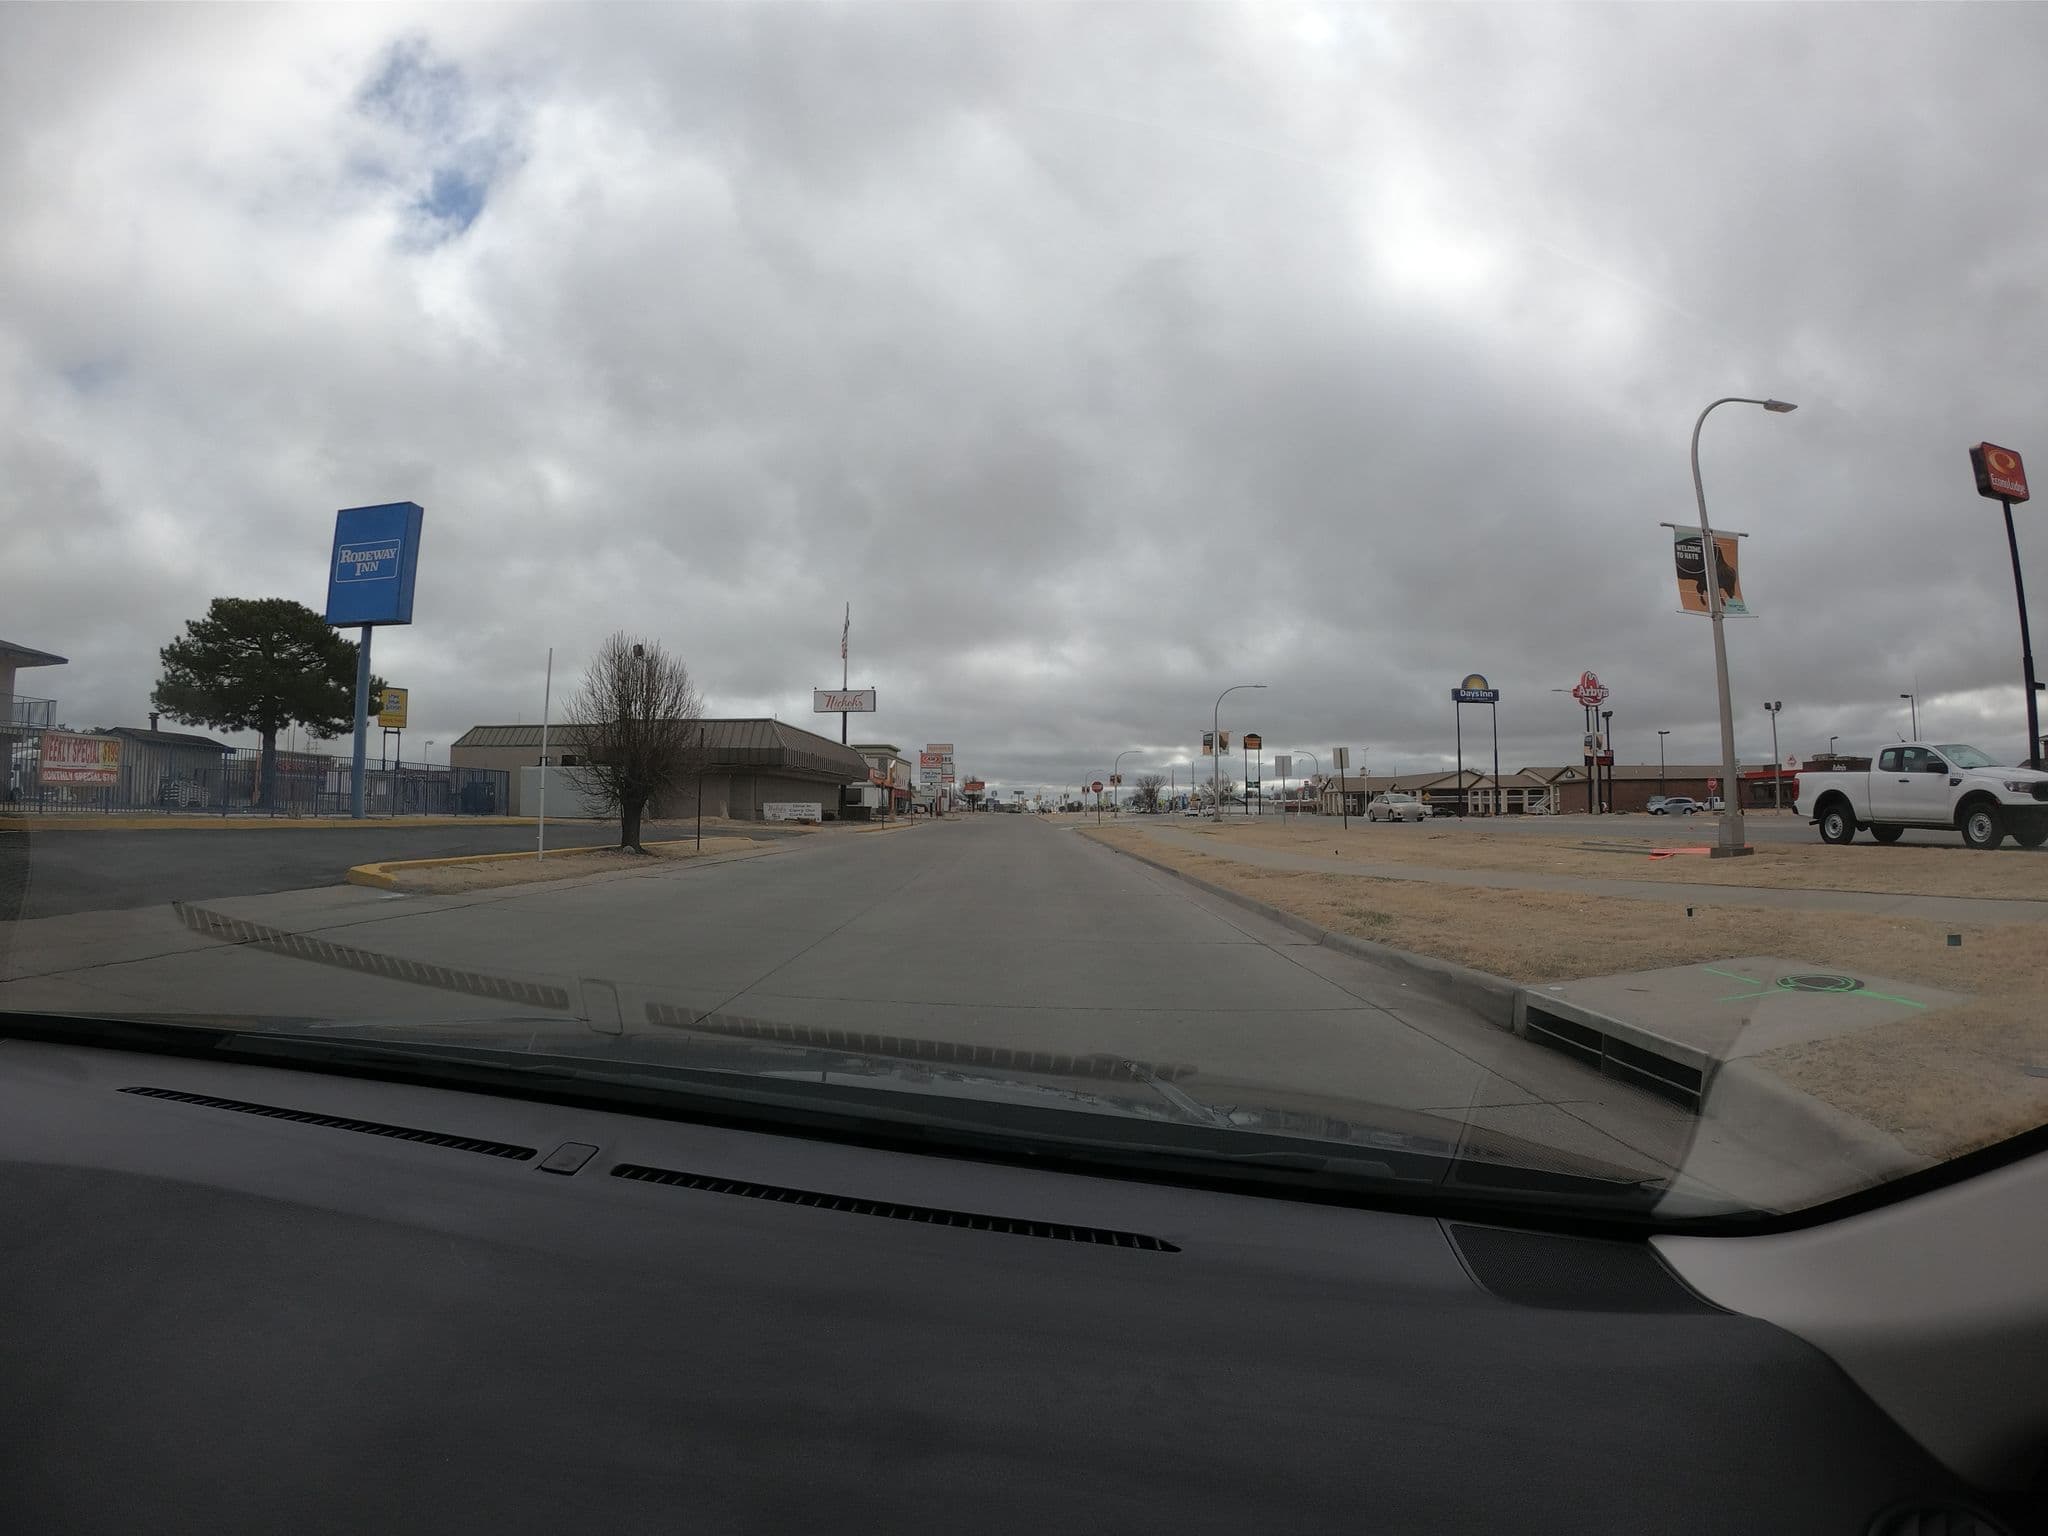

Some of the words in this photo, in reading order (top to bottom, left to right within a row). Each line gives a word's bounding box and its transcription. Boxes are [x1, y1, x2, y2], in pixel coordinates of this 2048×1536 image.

[1676, 544, 1701, 553] WELCOME
[340, 548, 398, 563] RODEWAY
[1676, 552, 1684, 560] TO
[355, 561, 380, 576] INN
[1460, 690, 1479, 698] Days
[1579, 685, 1609, 699] Arby's
[43, 735, 71, 762] WEEKLY
[72, 738, 99, 763] SPECIAL
[42, 770, 73, 781] MONTHLY
[75, 771, 101, 782] SPECIAL
